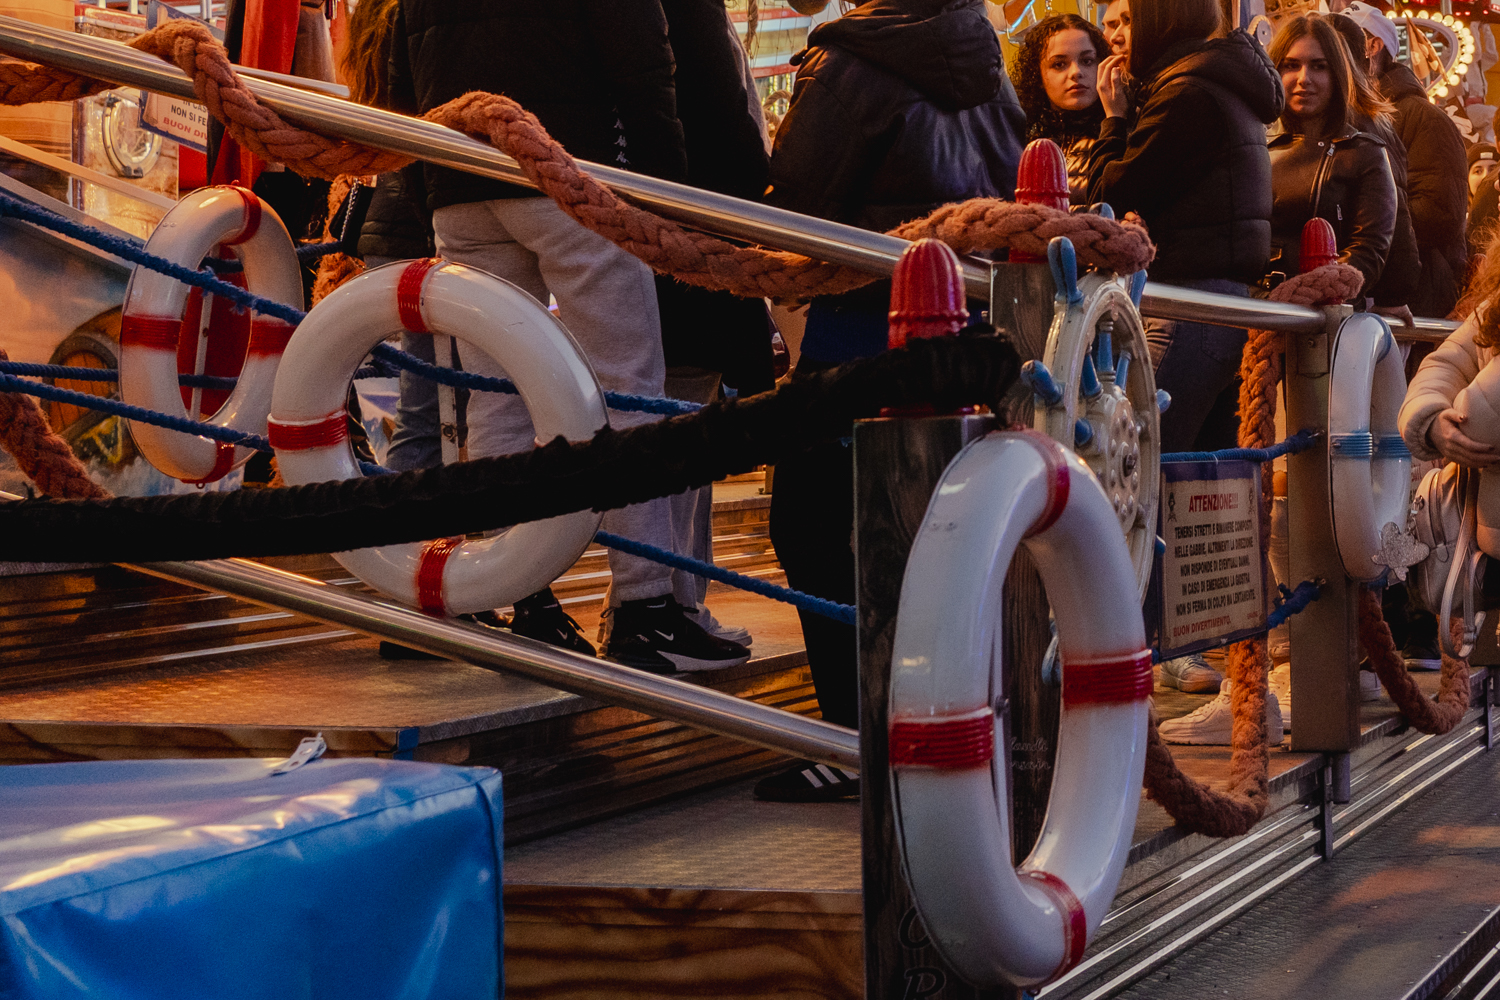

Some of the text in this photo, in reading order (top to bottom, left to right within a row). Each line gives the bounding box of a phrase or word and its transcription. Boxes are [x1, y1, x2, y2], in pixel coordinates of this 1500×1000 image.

[171, 104, 187, 118] NON
[189, 112, 196, 122] SI
[163, 117, 192, 133] BUON
[1174, 525, 1193, 540] TENERSI
[1194, 523, 1212, 537] STRETTI
[1235, 519, 1252, 532] COMPOSTI
[1174, 544, 1189, 559] NELLE
[1208, 539, 1230, 554] ALTRIMENTI
[1231, 539, 1235, 551] LA
[1235, 536, 1253, 550] DIREZIONE
[1180, 563, 1190, 577] NON
[1191, 560, 1213, 576] RISPONDE
[1213, 560, 1218, 572] DI
[1219, 557, 1238, 571] EVENTUALI
[1182, 572, 1250, 596] IN CASO DI EMERGENZA LA GIOSTRA
[1176, 602, 1186, 617] NON
[1187, 601, 1191, 615] SI
[1192, 598, 1207, 613] FERMA
[1208, 597, 1213, 610] DI
[1213, 594, 1226, 609] COLPO
[1227, 593, 1232, 606] MA
[1173, 623, 1190, 637] BUON
